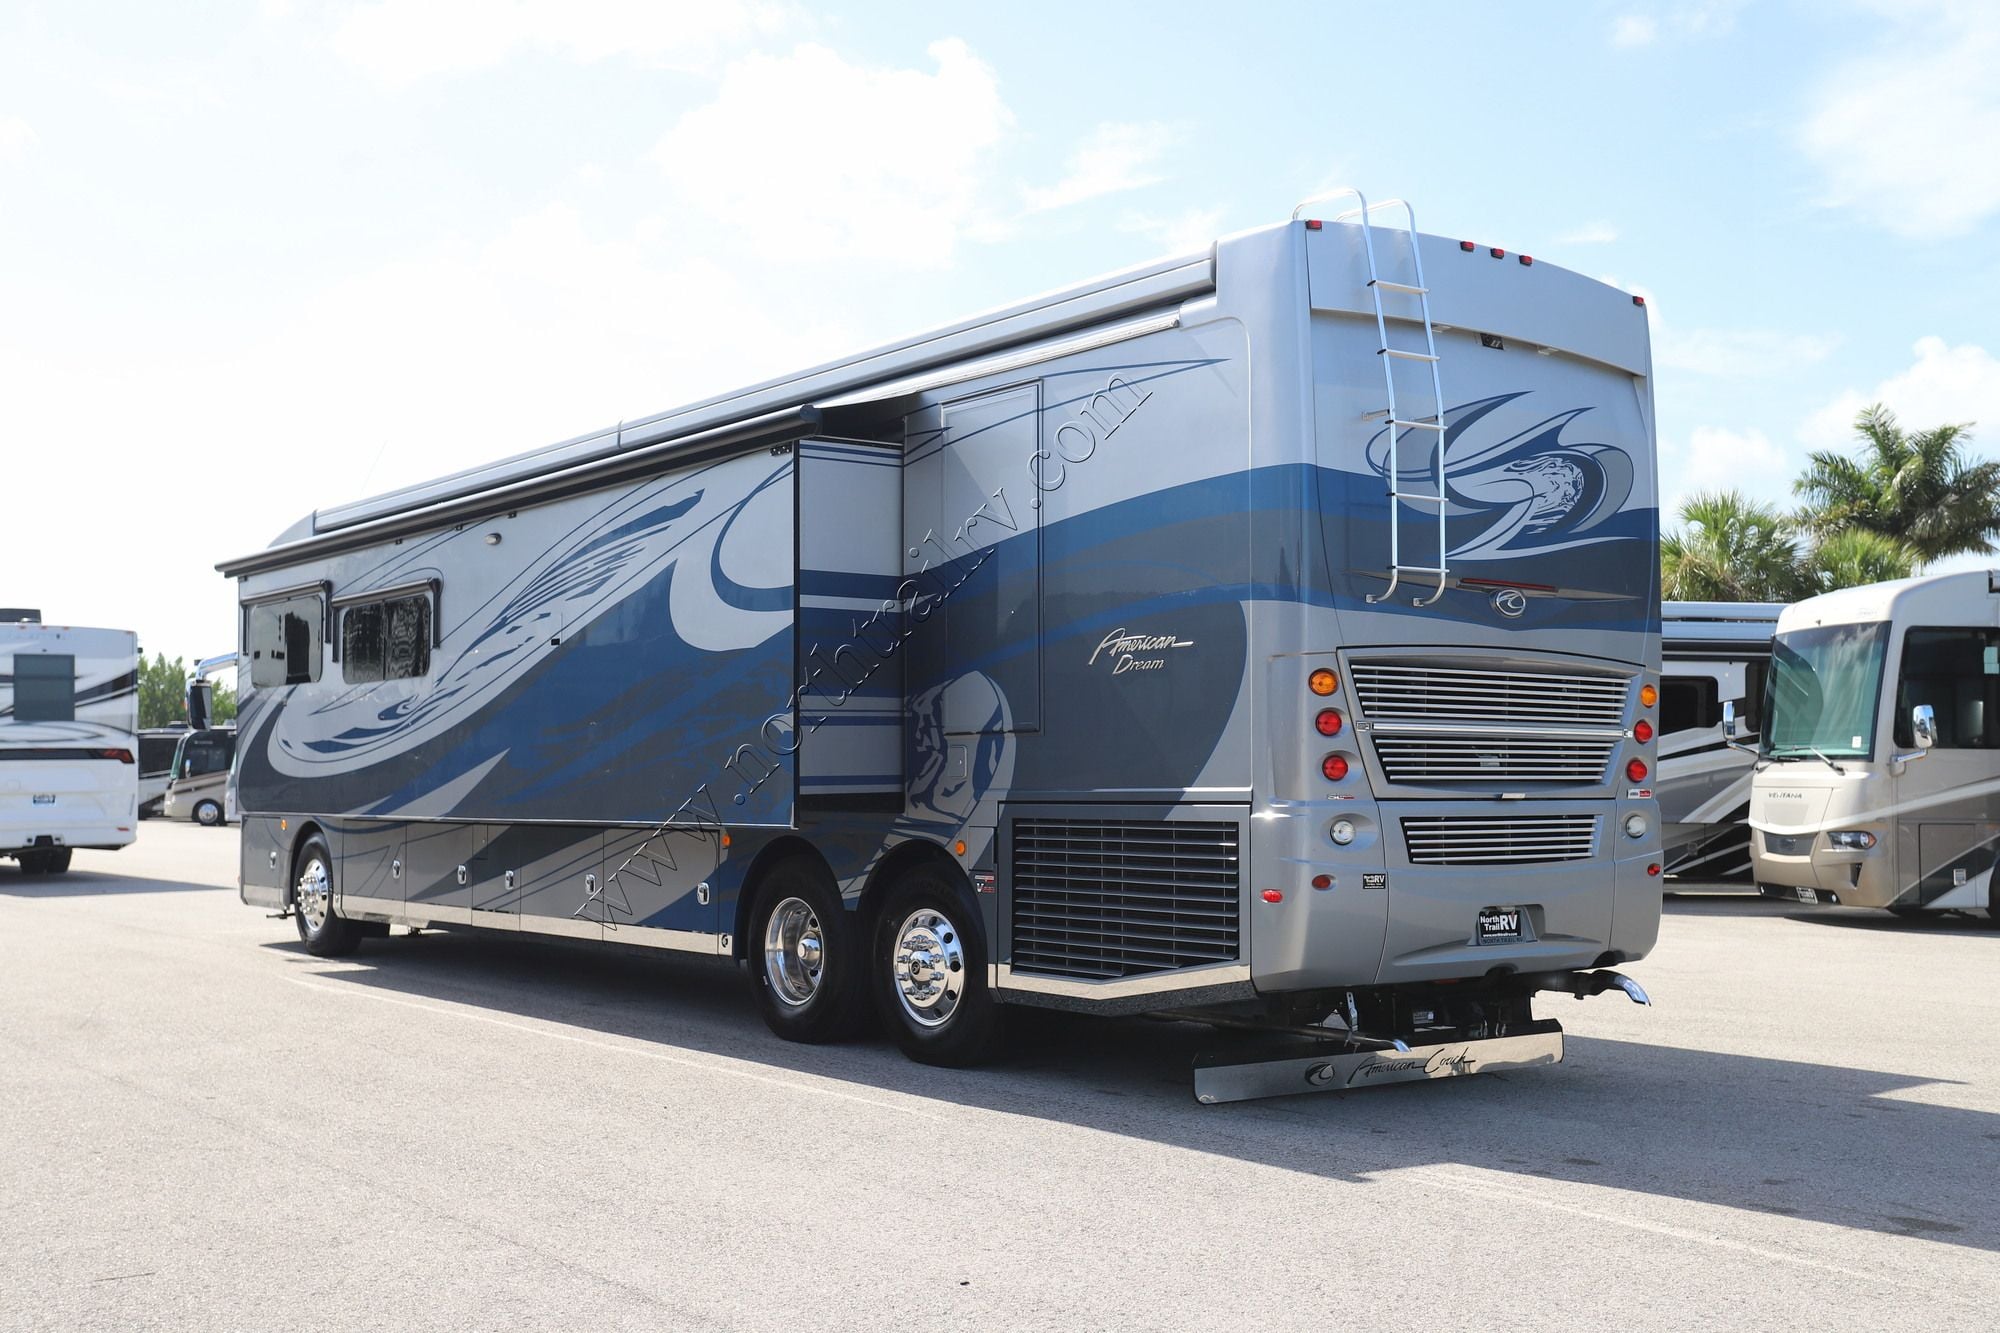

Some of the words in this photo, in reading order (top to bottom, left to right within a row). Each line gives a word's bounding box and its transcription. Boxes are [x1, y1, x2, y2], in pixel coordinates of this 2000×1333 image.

[1088, 627, 1194, 665] American
[1112, 654, 1164, 675] Dream
[1500, 915, 1517, 930] RV
[1347, 1056, 1424, 1085] American
[1422, 1047, 1476, 1074] Coach
